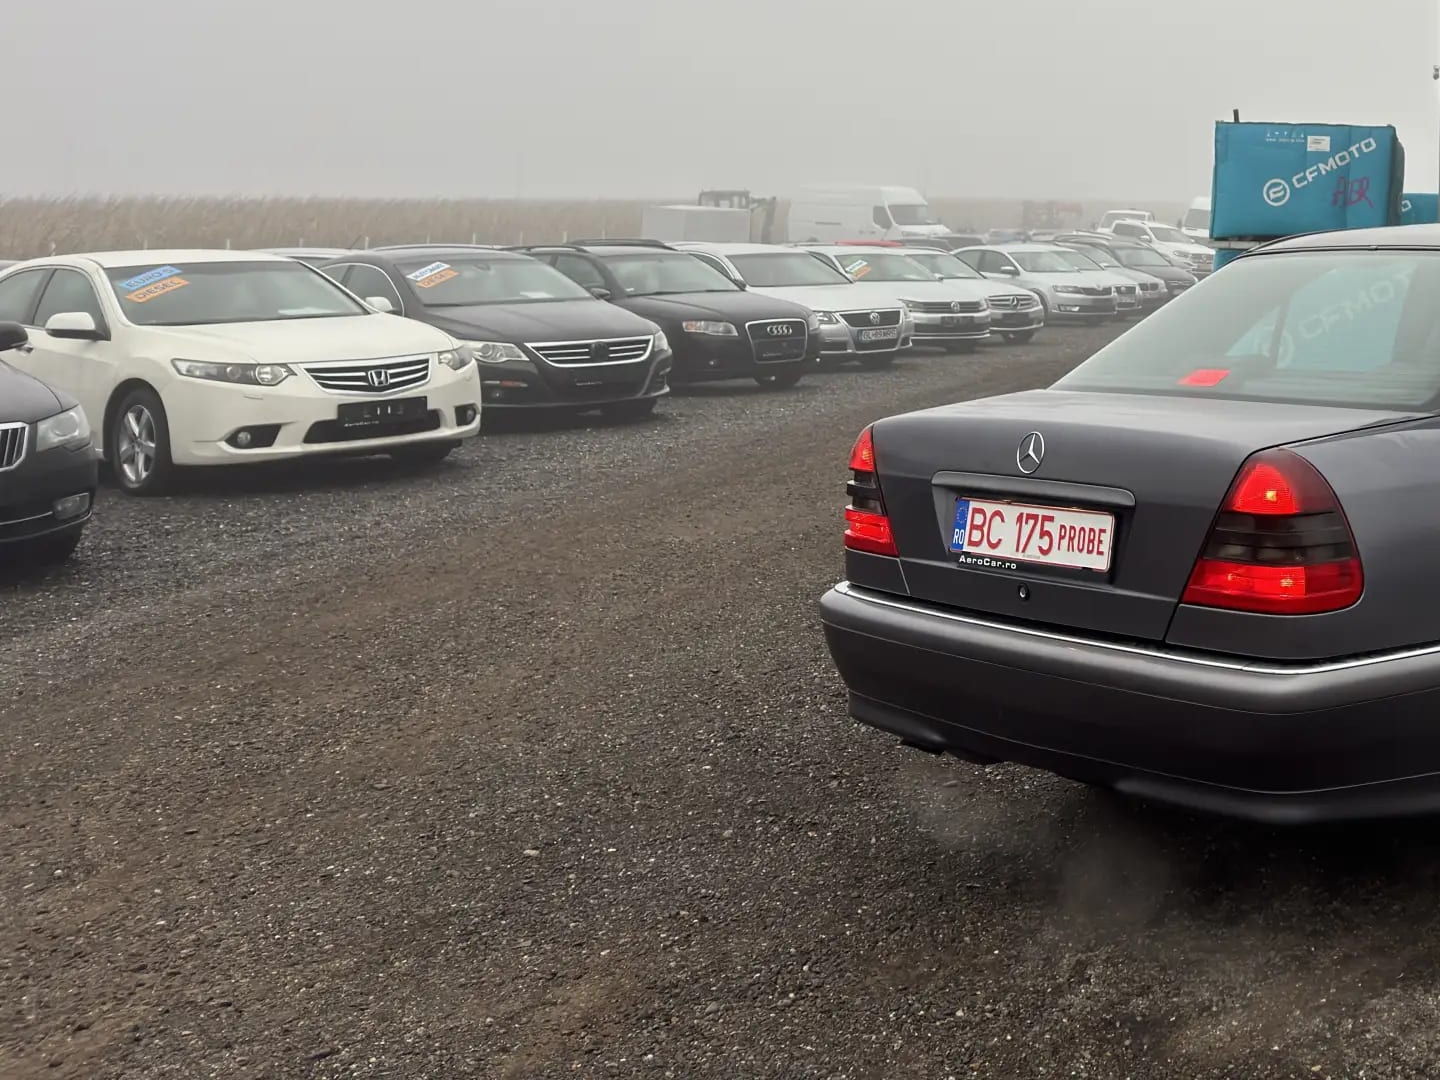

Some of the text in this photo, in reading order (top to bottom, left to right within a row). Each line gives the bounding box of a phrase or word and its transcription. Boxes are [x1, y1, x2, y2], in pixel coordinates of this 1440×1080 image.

[1292, 137, 1377, 189] CFMOTO
[952, 528, 965, 545] RO
[967, 506, 1107, 556] BC 175 PROBE
[959, 554, 1017, 570] AeroCar.ro
